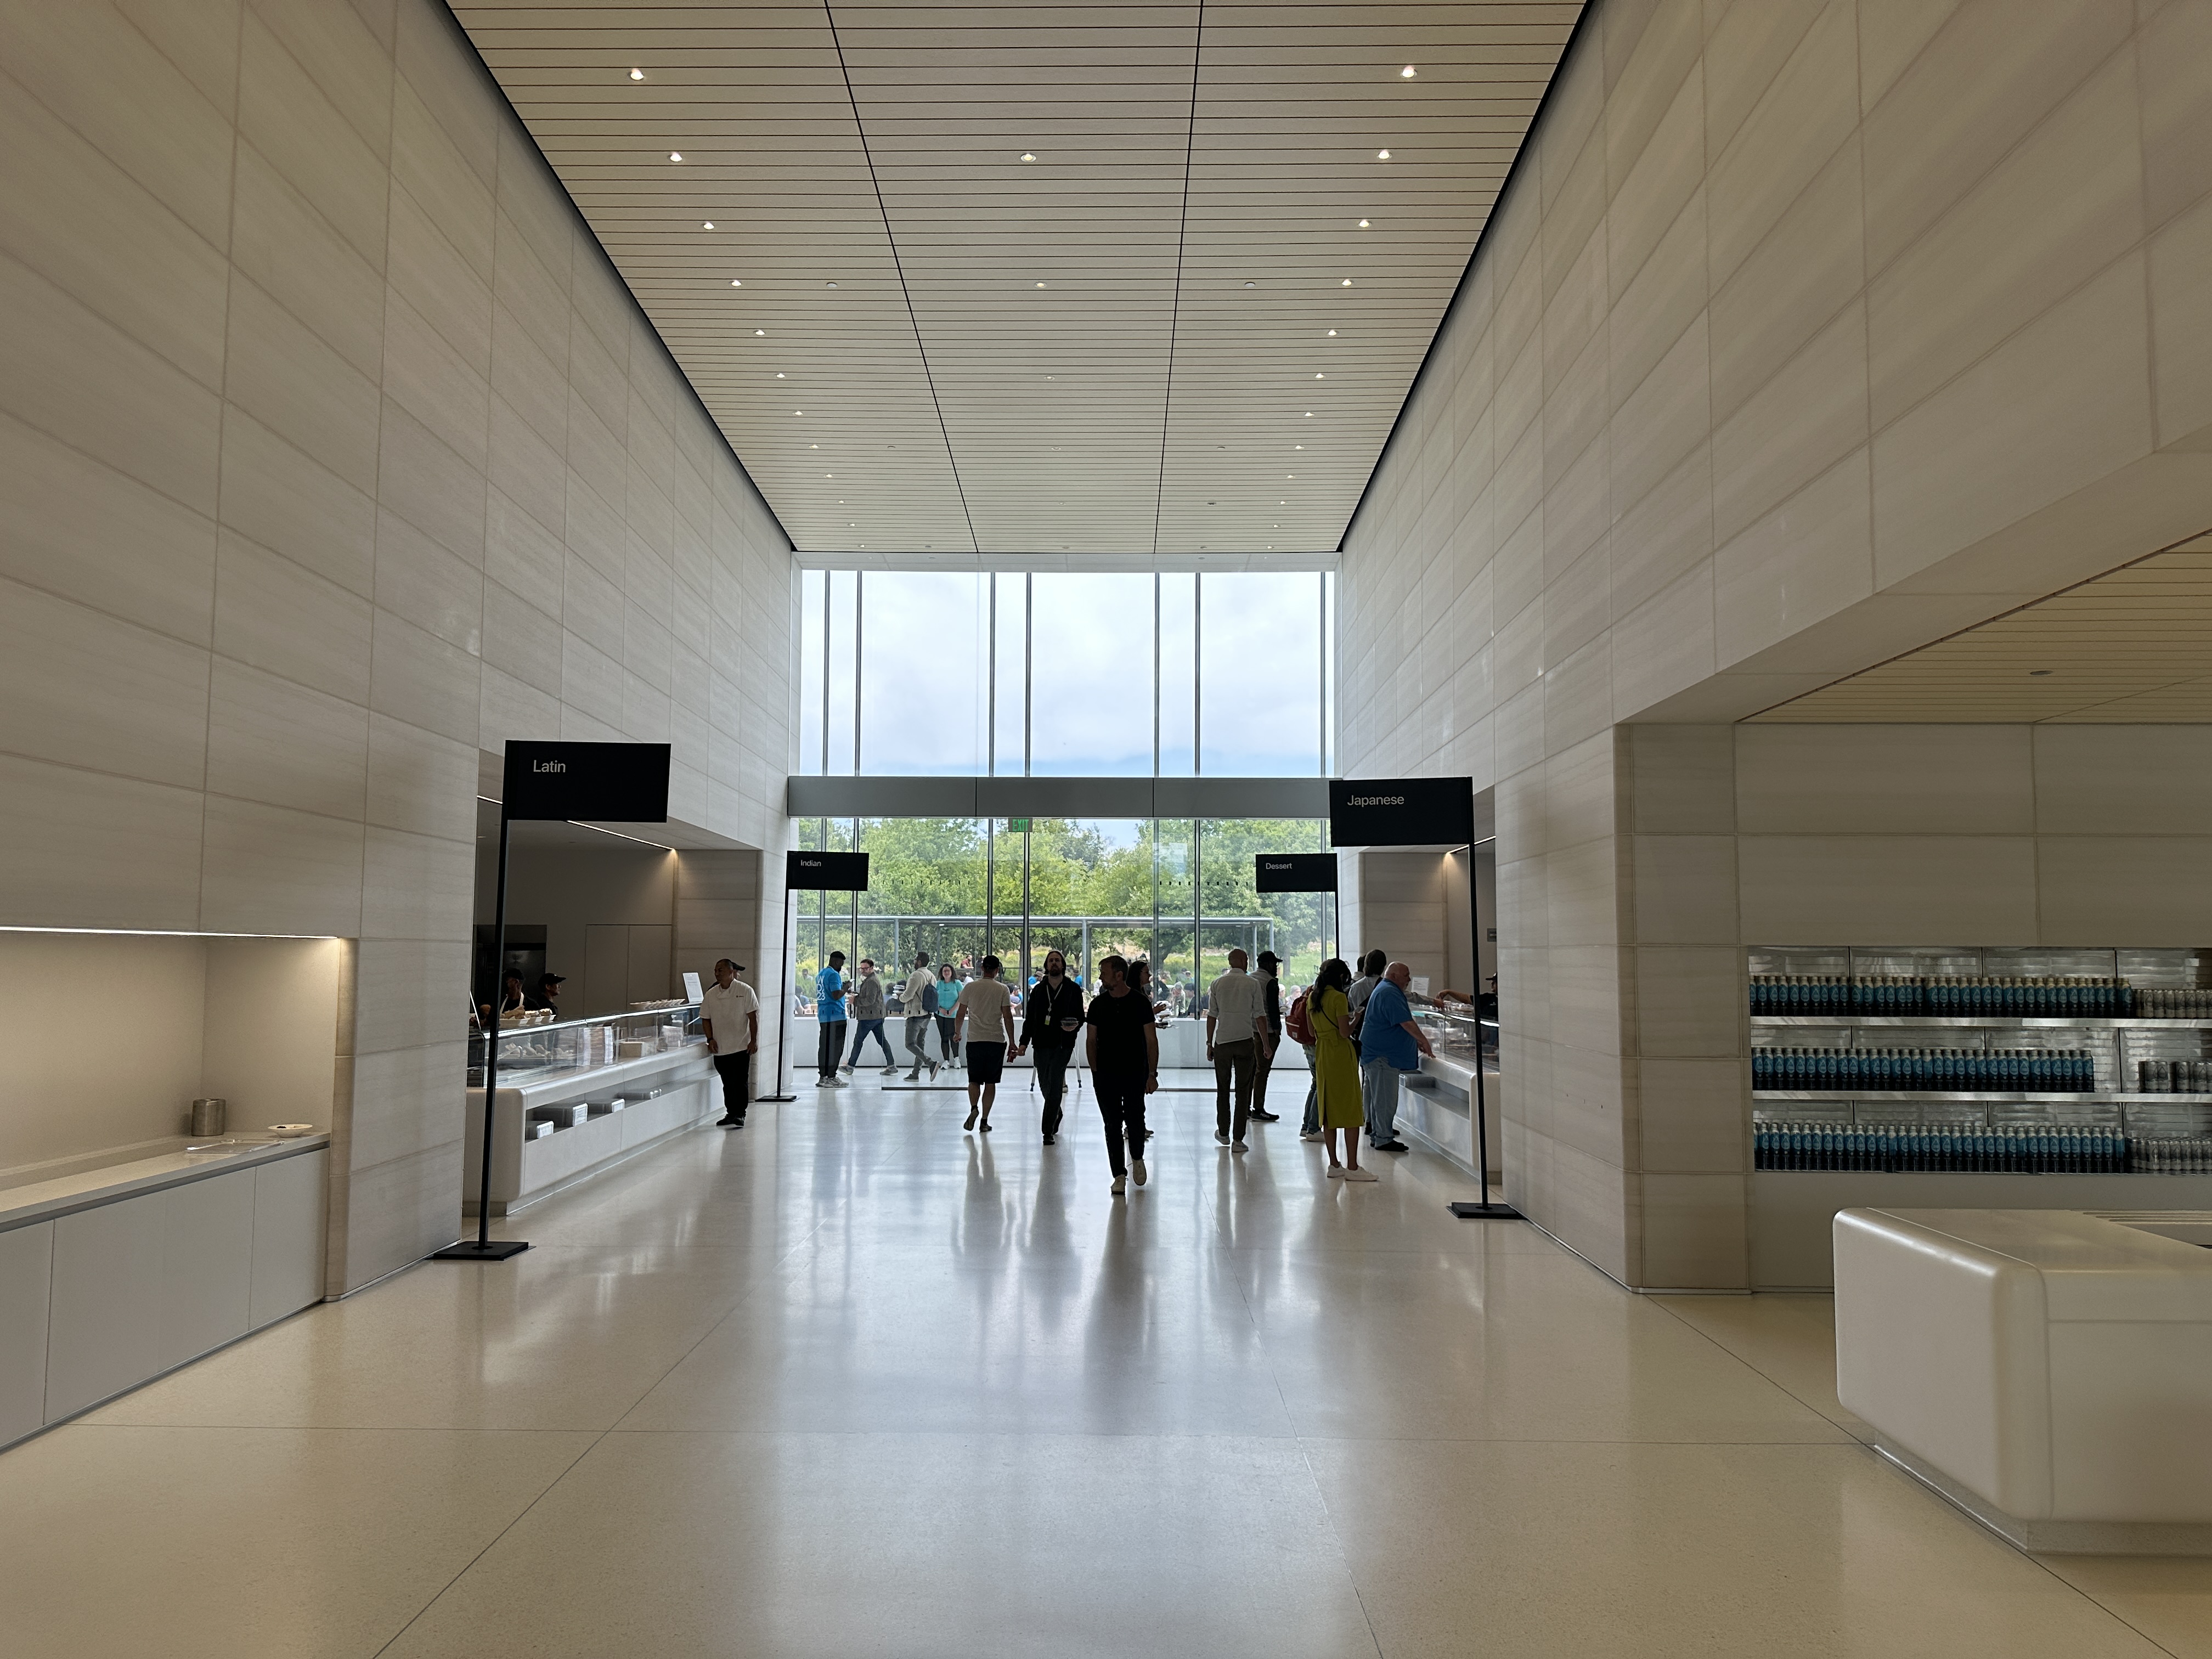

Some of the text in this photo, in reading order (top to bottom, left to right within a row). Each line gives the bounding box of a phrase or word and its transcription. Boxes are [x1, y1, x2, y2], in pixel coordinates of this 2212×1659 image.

[533, 759, 566, 773] Latin
[1347, 794, 1404, 808] Japanese
[1012, 819, 1029, 832] EXIT
[816, 991, 826, 1001] 23
